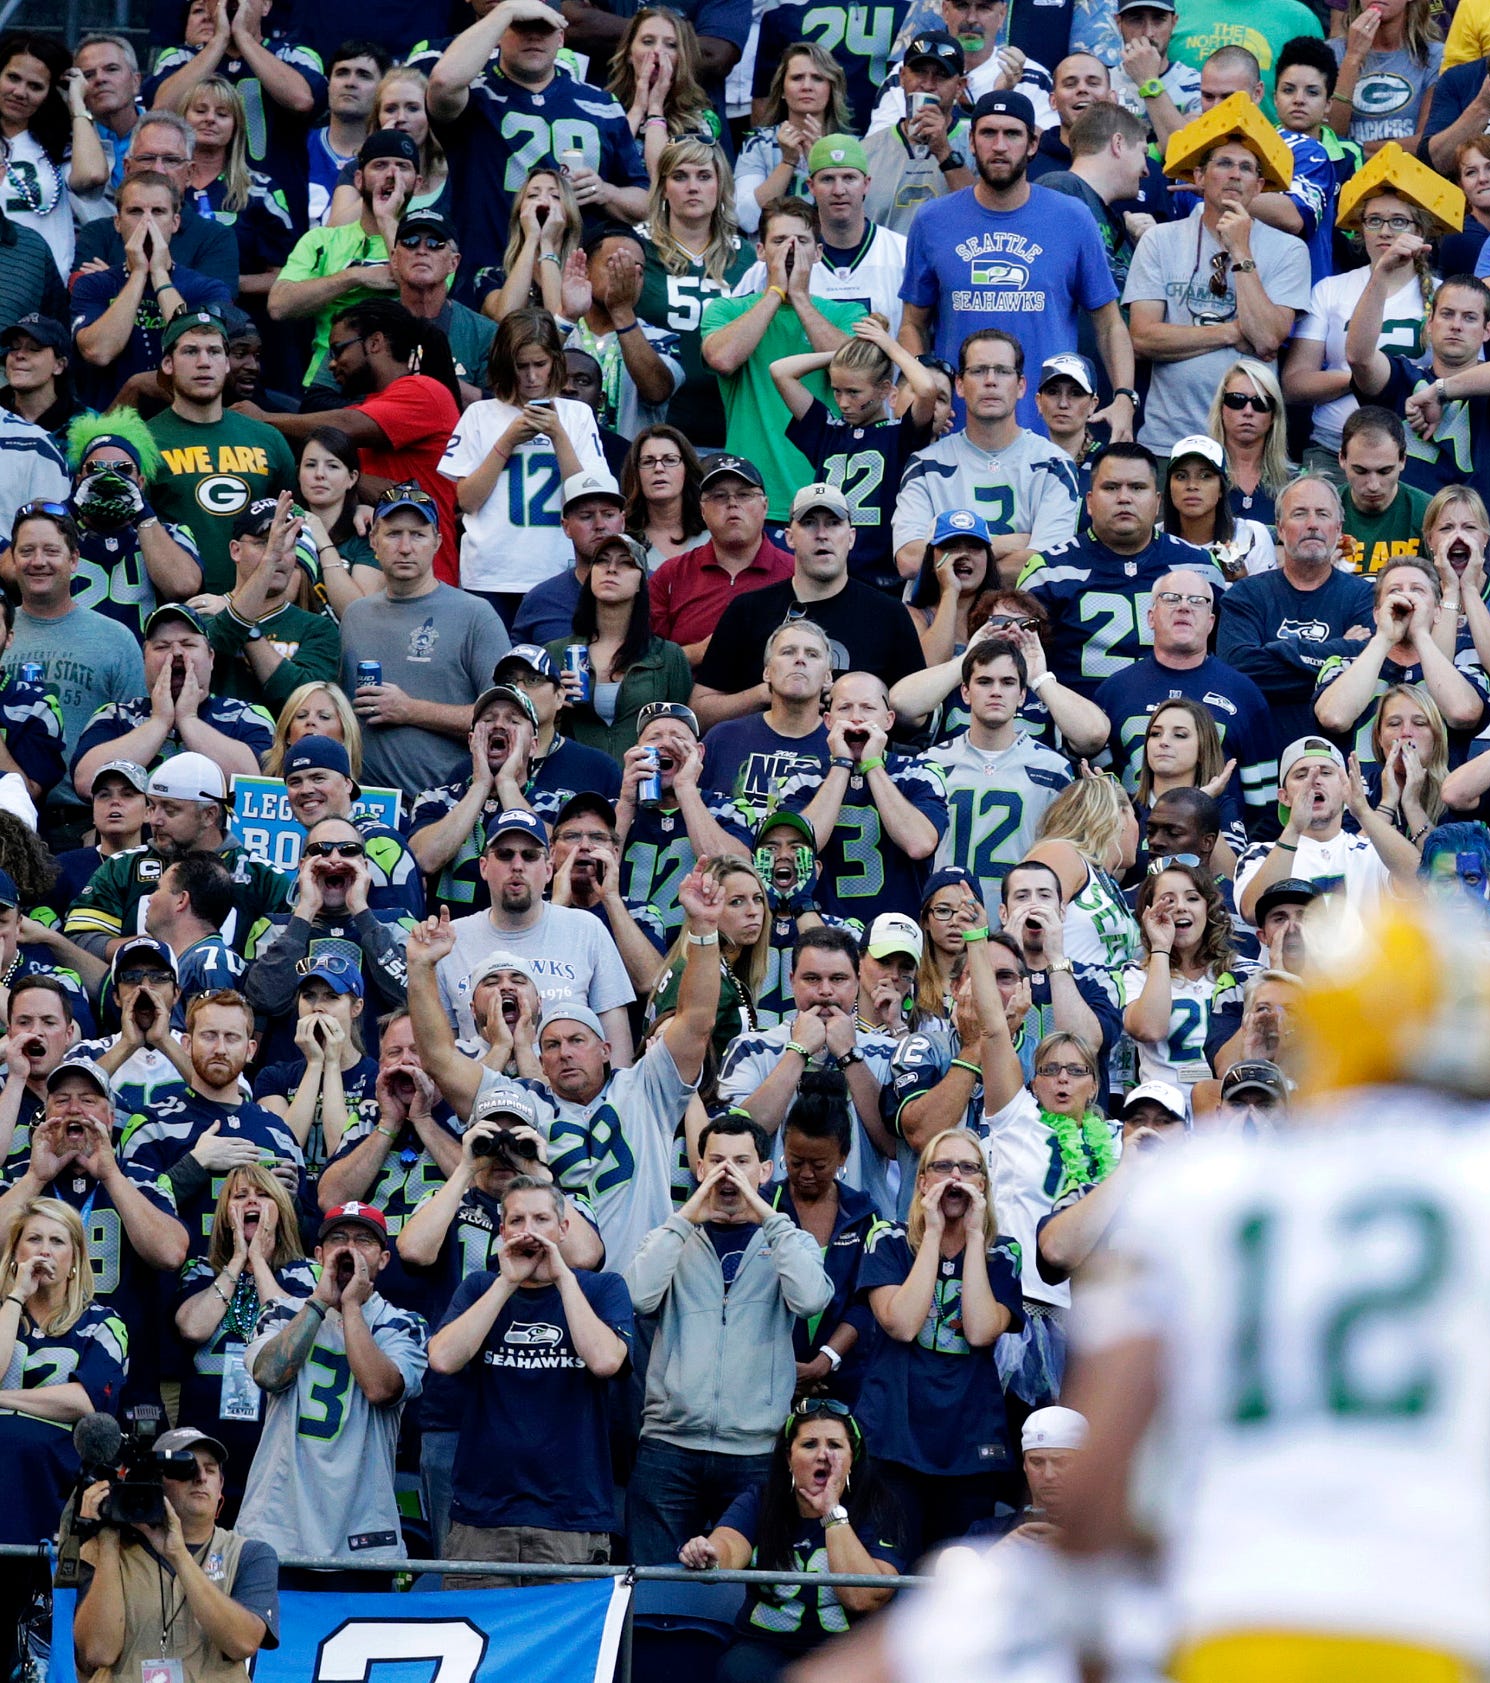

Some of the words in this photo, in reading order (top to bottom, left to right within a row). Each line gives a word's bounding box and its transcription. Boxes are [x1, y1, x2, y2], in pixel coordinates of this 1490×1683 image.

[1214, 23, 1245, 37] THE
[955, 232, 1043, 263] SEATTLE
[953, 290, 1045, 312] SEAHAWKS
[161, 449, 214, 475] WE
[219, 446, 269, 475] ARE
[503, 452, 563, 527] 12
[824, 450, 884, 526] 12
[72, 552, 157, 634] 24
[54, 660, 94, 690] STATE
[949, 788, 1023, 881] 12
[836, 805, 885, 898] 3
[624, 836, 705, 928] 12
[196, 946, 248, 977] 70
[541, 986, 573, 1001] 1976
[892, 1036, 931, 1065] 12
[478, 1098, 533, 1115] CHAMPIONS
[548, 1103, 634, 1196] 29
[458, 1212, 494, 1230] XLVIII
[1234, 1195, 1457, 1424] 12
[484, 1351, 587, 1369] SEAHAWKS
[499, 1347, 567, 1356] SEATTLE
[299, 1344, 354, 1442] 3
